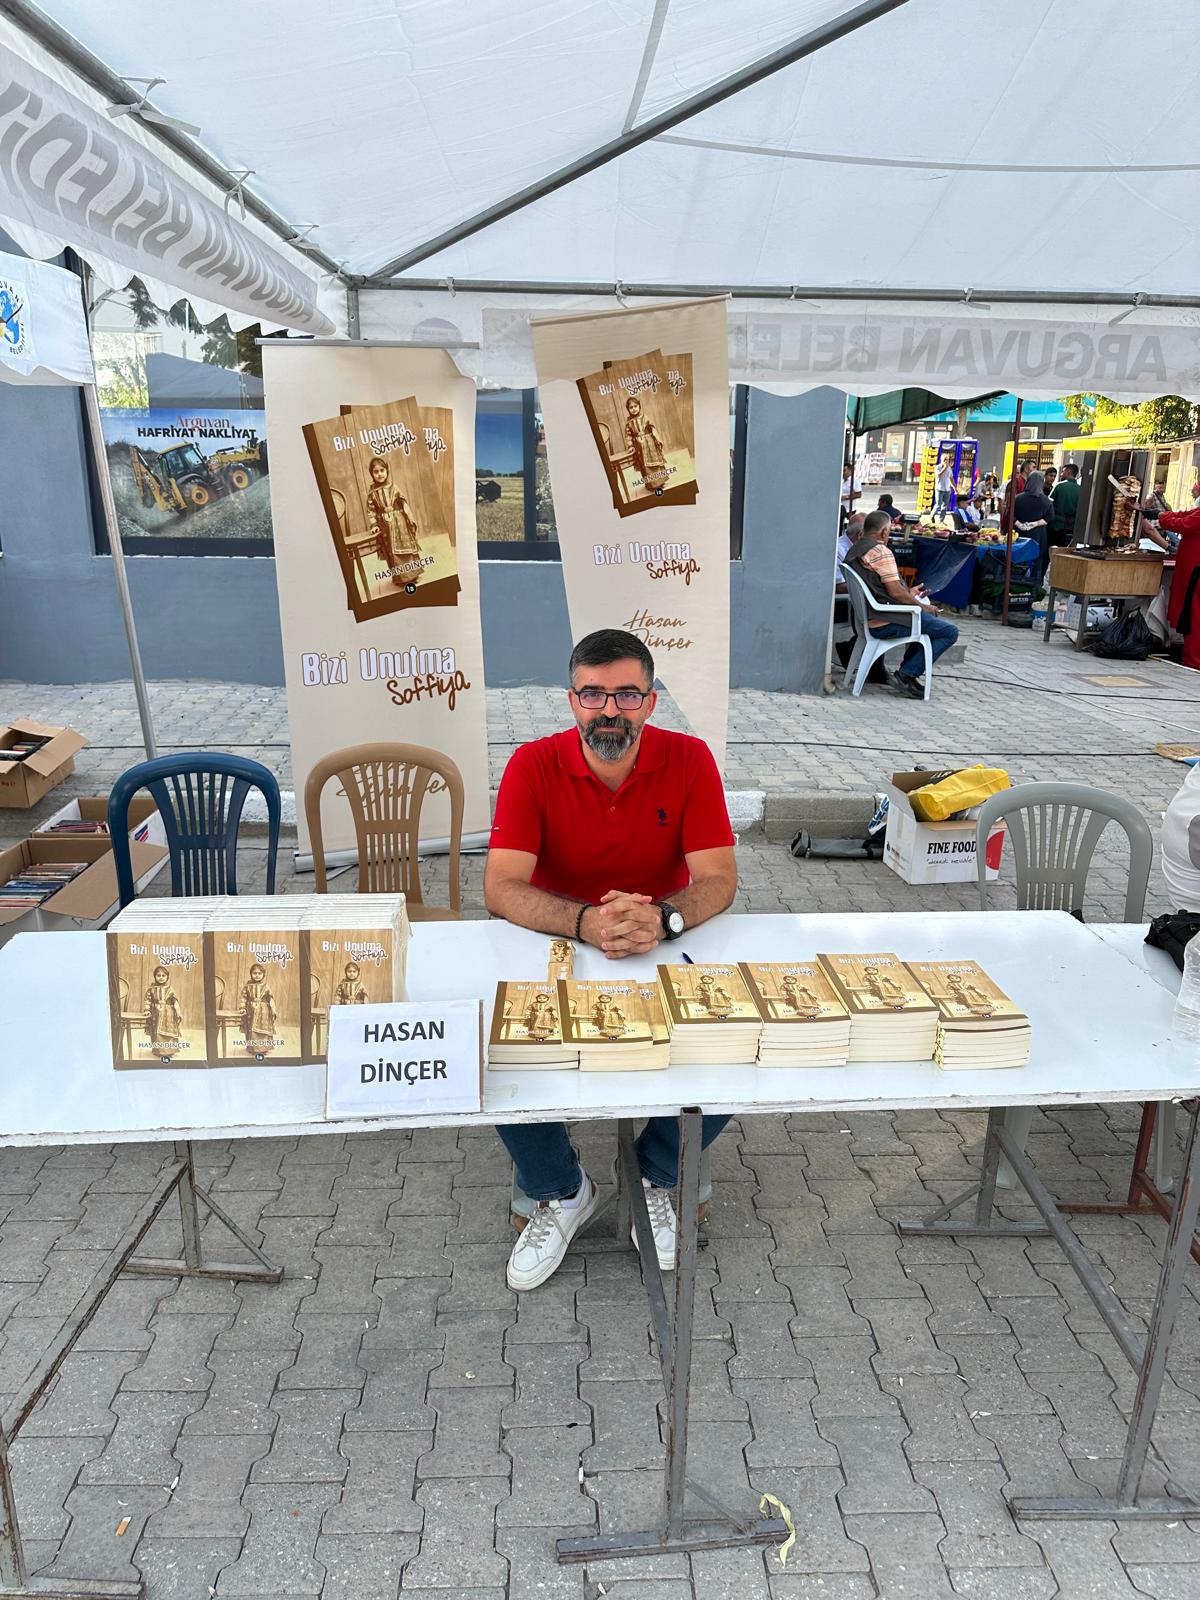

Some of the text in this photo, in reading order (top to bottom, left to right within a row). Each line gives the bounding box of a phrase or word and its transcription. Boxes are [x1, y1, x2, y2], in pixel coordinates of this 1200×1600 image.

[137, 425, 256, 439] HAFRİYAT NAKLİYAT
[176, 415, 230, 432] Arguvan
[333, 422, 406, 452] Bizi Unutma
[593, 541, 691, 566] Bizi Unutma
[374, 556, 435, 581] HASAN DİNÇER
[646, 558, 700, 586] Soffiya
[622, 609, 687, 629] Hasan
[301, 646, 456, 686] Bizi Unutma
[386, 670, 471, 711] Soffiya
[927, 840, 977, 854] FINE FOOD
[364, 1020, 445, 1043] HASAN
[361, 1058, 448, 1086] DİNÇER
